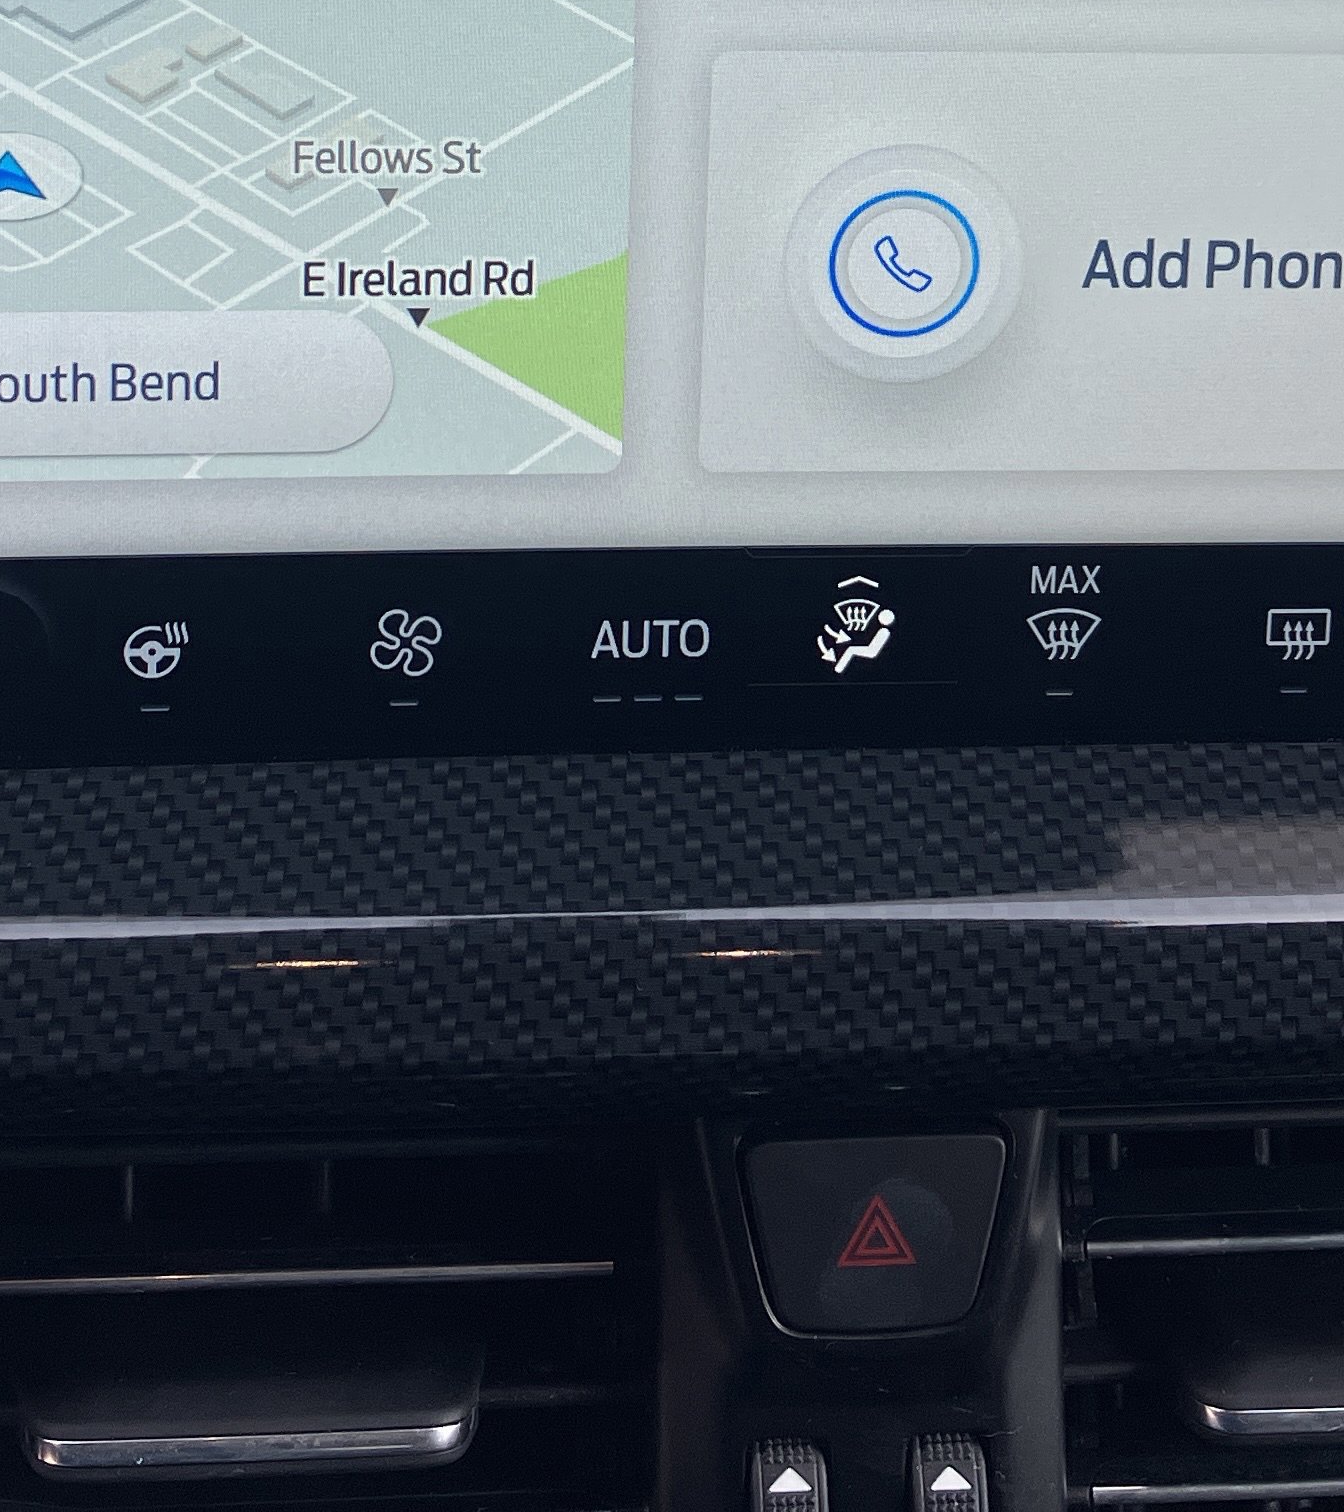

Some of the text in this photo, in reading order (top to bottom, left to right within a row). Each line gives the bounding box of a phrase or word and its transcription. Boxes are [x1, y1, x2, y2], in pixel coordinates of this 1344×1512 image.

[294, 139, 482, 175] Fellows St
[303, 259, 534, 297] E Ireland Rd
[1081, 237, 1191, 289] Add
[111, 360, 219, 402] Bend
[1030, 565, 1101, 594] MAX
[590, 618, 710, 659] AUTO
